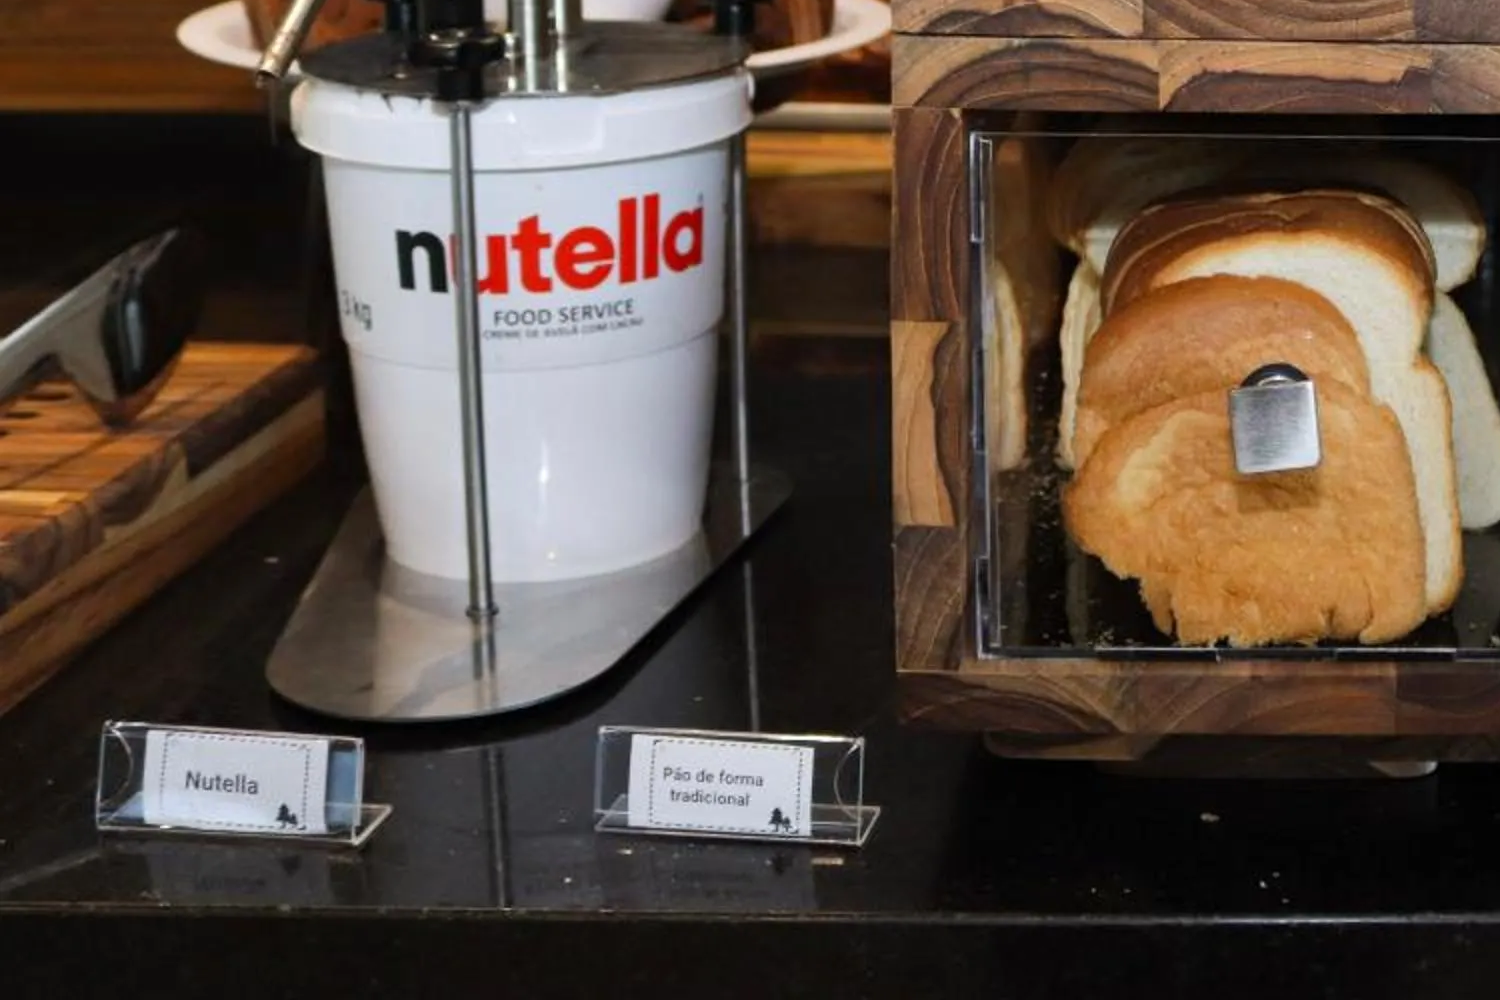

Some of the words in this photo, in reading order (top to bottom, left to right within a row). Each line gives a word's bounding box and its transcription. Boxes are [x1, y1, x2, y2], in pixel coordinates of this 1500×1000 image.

[395, 193, 705, 295] nutella
[493, 308, 553, 327] FOOD
[558, 298, 635, 324] SERVICE
[184, 769, 260, 796] Nutella
[663, 765, 692, 782] Pão
[695, 768, 715, 785] de
[719, 771, 765, 788] forma
[669, 788, 750, 807] tradicional
